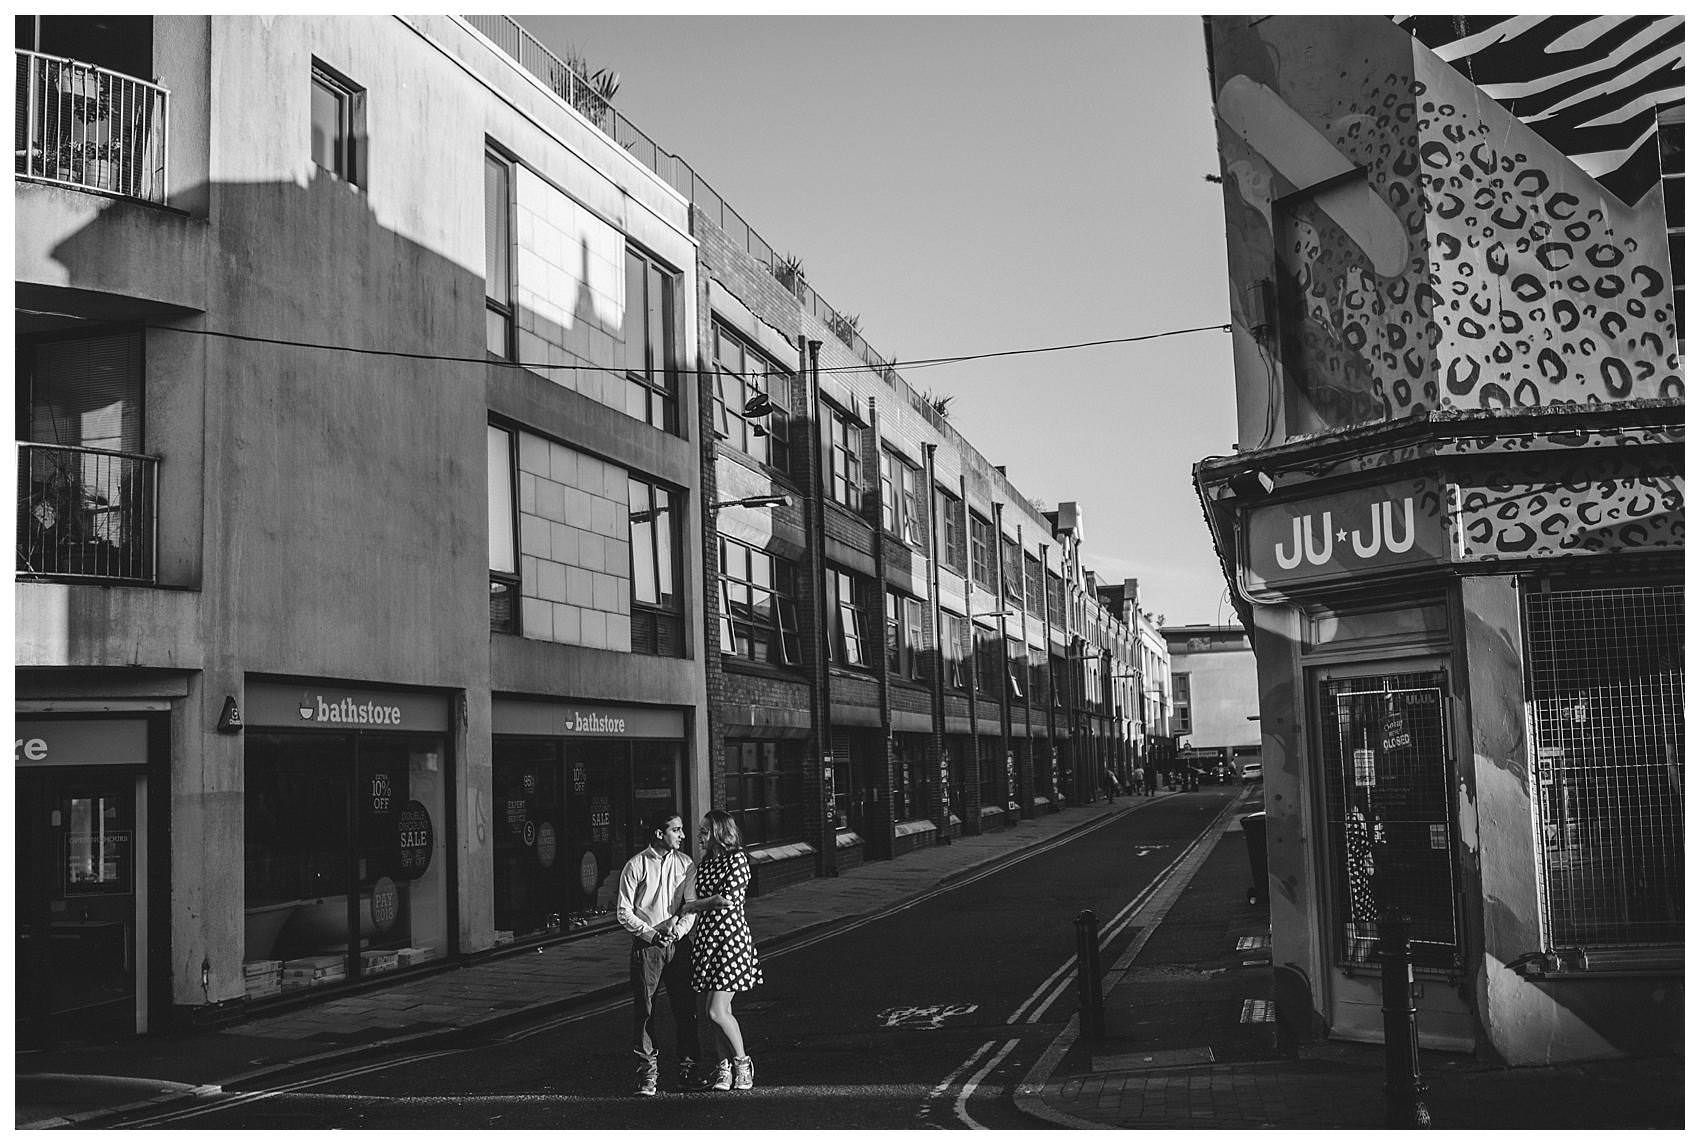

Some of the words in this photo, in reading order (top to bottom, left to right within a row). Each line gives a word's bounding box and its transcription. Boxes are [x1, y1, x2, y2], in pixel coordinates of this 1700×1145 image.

[1275, 511, 1333, 570] JU
[1351, 497, 1415, 559] JU
[316, 695, 401, 725] bathstore
[575, 711, 625, 733] bathstore
[372, 780, 392, 797] 10%
[373, 797, 390, 810] OFF
[592, 812, 610, 826] SALE
[400, 831, 428, 848] SALE
[375, 892, 393, 908] PAY
